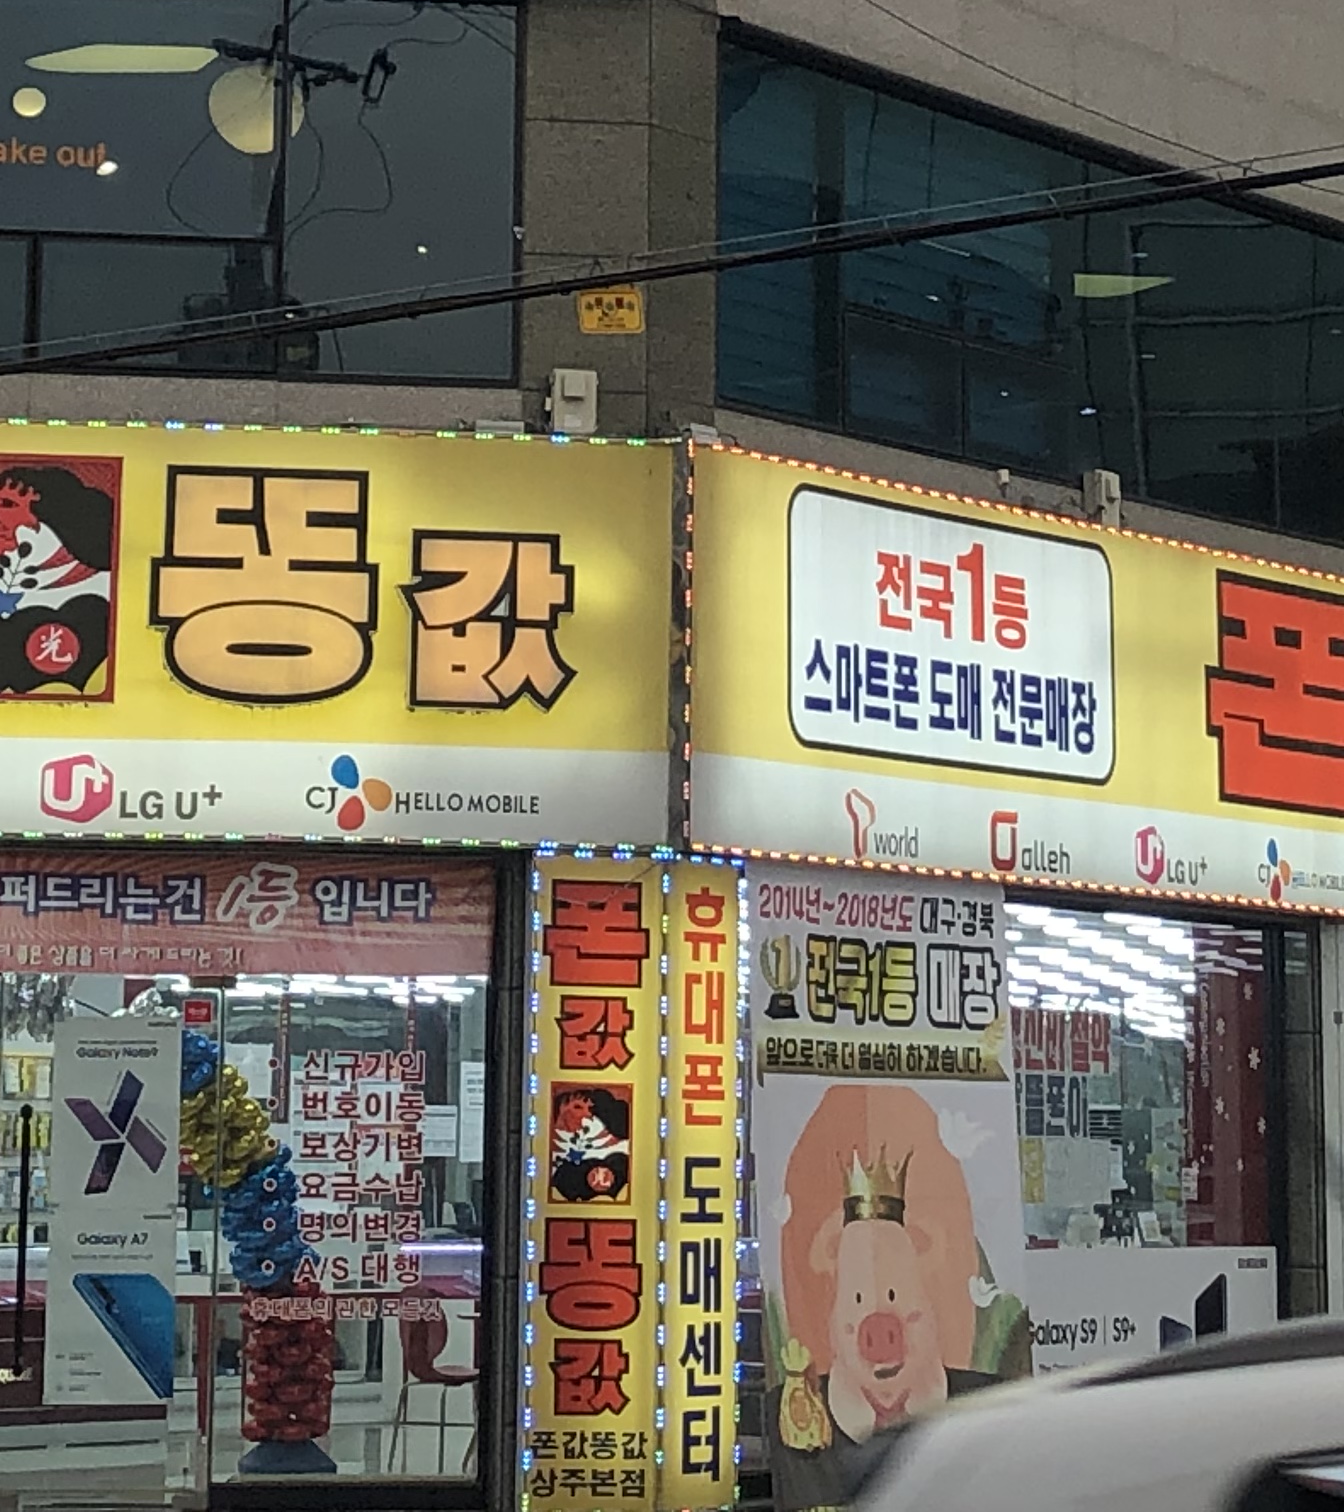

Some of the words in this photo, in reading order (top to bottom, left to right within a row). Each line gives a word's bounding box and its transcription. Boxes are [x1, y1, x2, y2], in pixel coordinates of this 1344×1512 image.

[56, 141, 107, 169] out
[875, 543, 1029, 650] 전국1등
[803, 638, 919, 733] 스마트폰
[929, 656, 982, 741] 도매
[992, 667, 1096, 756] 전문매장
[120, 790, 164, 820] LG
[306, 787, 337, 814] CJ
[395, 791, 463, 813] HELLO
[467, 790, 540, 814] MOBILE
[874, 826, 919, 859] world
[1021, 840, 1070, 875] olleh
[1167, 857, 1185, 885] LG
[1258, 863, 1271, 888] CJ
[758, 884, 915, 933] 2014년~2018년도
[543, 879, 650, 1072] 폰값
[806, 933, 918, 1027] 전국1등
[926, 942, 1002, 1030] 매장
[681, 886, 727, 1127] 휴대폰
[302, 1050, 426, 1084] 신규가입
[766, 1037, 814, 1068] 앞으로
[858, 1041, 902, 1072] 열심히
[906, 1044, 987, 1075] 하겠습니다.
[301, 1090, 426, 1124] 번호이동
[299, 1131, 425, 1164] 보상기변
[298, 1171, 423, 1206] 요금수납
[77, 1232, 128, 1248] Galaxy
[130, 1232, 149, 1245] A7
[298, 1212, 422, 1245] 명의변경
[294, 1254, 350, 1285] A/S
[361, 1251, 422, 1285] 대행
[538, 1218, 644, 1417] 똥값
[679, 1156, 724, 1483] 도매센터
[1080, 1318, 1098, 1344] S9
[1112, 1316, 1137, 1343] S9+
[532, 1430, 648, 1461] 폰값똥값
[530, 1468, 647, 1499] 상주본점
